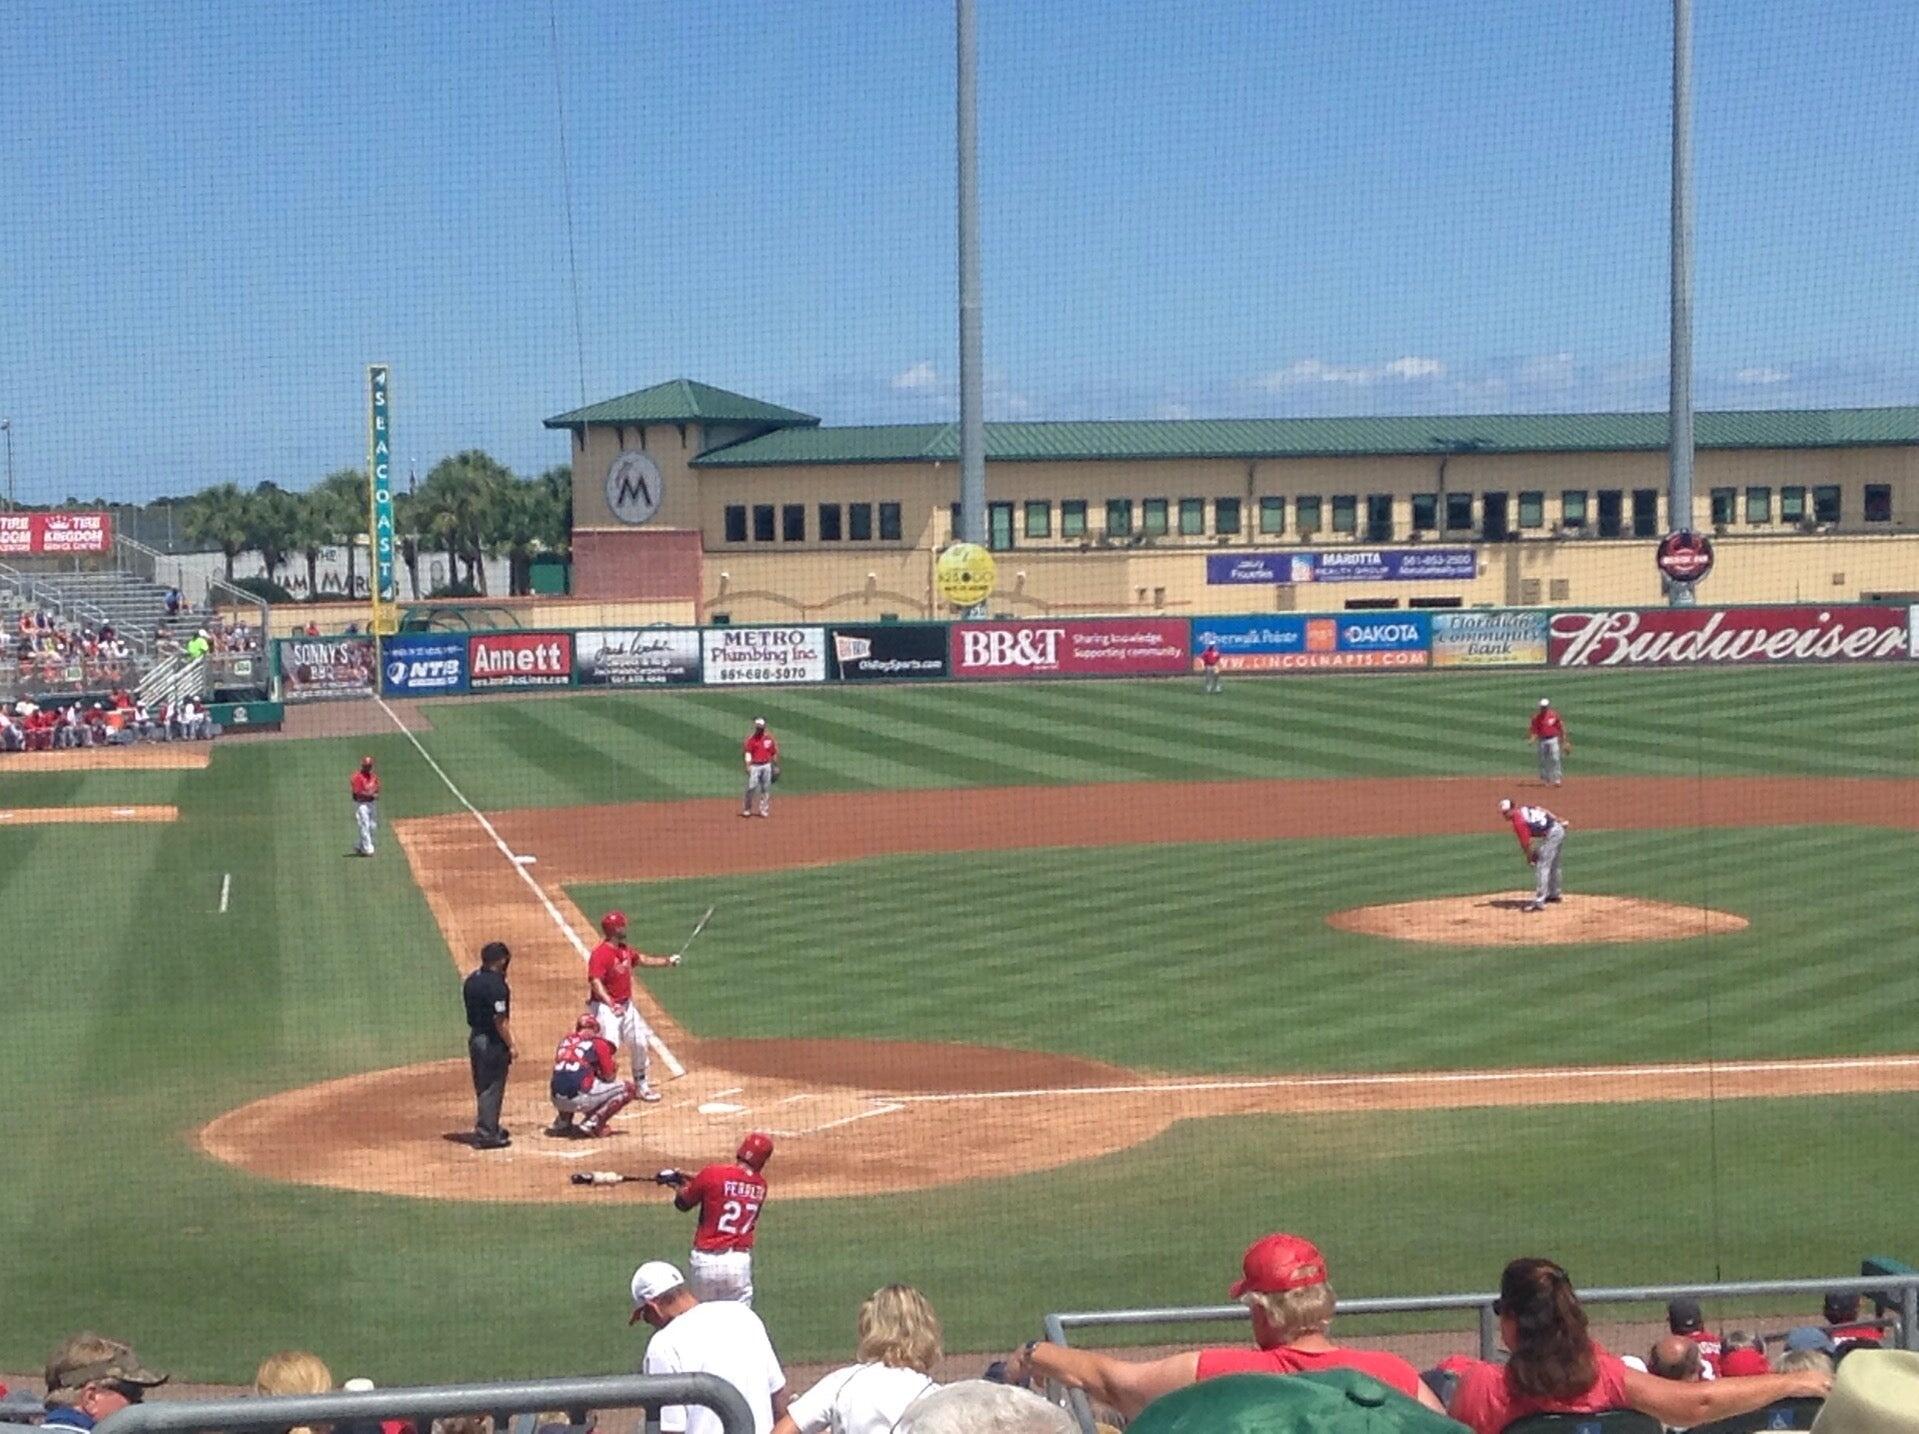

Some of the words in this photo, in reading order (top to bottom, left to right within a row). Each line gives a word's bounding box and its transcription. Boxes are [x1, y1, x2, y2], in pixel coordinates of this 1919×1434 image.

[375, 391, 391, 577] SEACOAST
[44, 530, 103, 543] KINGDOM
[1322, 553, 1382, 566] MAROTTA
[1450, 614, 1530, 629] Floridian
[723, 630, 805, 646] METRO
[1072, 632, 1109, 646] Sharing
[1349, 624, 1418, 643] DAKOTA
[1437, 629, 1538, 643] Community
[1550, 611, 1907, 666] Budweiser
[294, 643, 348, 665] SONNY'S
[711, 647, 788, 665] Plumbing
[792, 646, 818, 660] Inc.
[960, 628, 1066, 667] BB&T
[1073, 647, 1126, 660] Supporting
[1468, 641, 1511, 655] Bank
[474, 642, 561, 672] Annett
[310, 665, 335, 680] BBQ
[718, 1200, 759, 1234] 27
